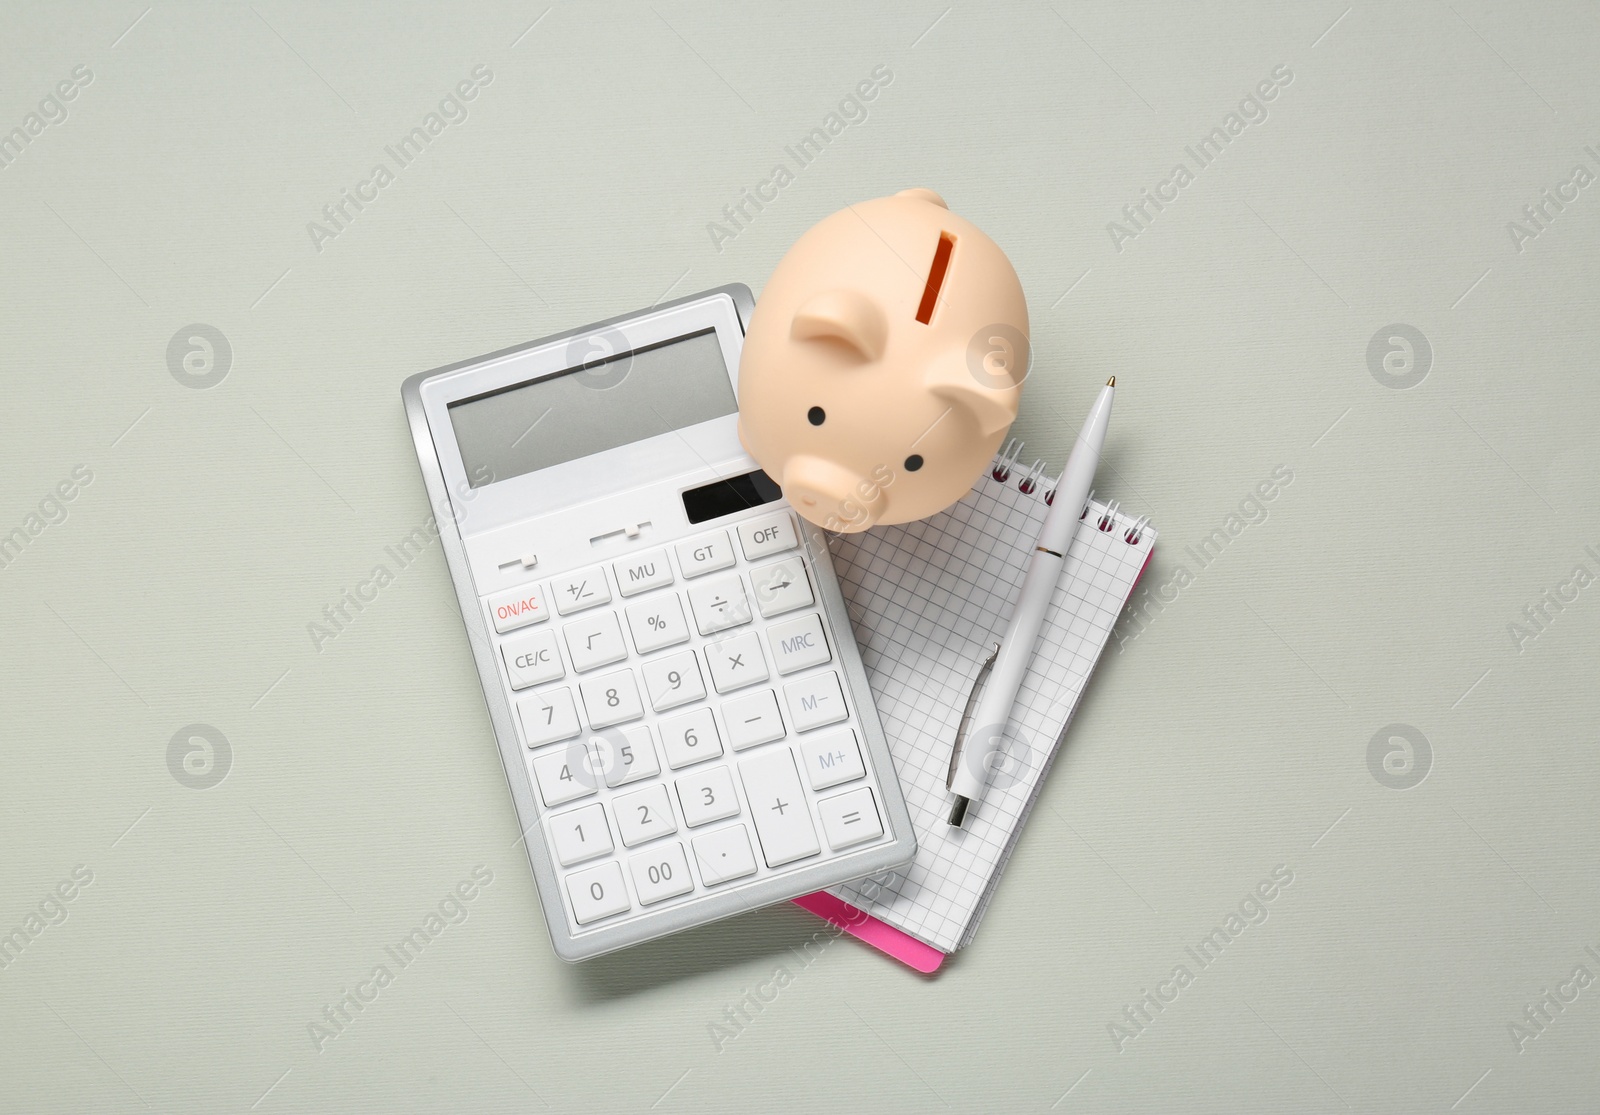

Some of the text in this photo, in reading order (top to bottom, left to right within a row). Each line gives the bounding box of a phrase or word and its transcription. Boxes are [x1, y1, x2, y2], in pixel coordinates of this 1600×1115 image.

[497, 596, 539, 620] ON/AC
[628, 562, 656, 582] MU
[693, 545, 714, 562] GT
[753, 526, 780, 544] OFF
[515, 647, 551, 669] CE/C
[647, 614, 667, 632] %
[541, 706, 554, 726] 7
[605, 688, 620, 708] 8
[667, 671, 682, 690] 9
[781, 632, 815, 654] MRC
[559, 764, 574, 783] 4
[620, 746, 634, 765] 5
[684, 728, 698, 748] 6
[574, 825, 585, 842] 1
[637, 805, 653, 825] 2
[700, 786, 715, 806] 3
[818, 751, 846, 770] M+
[590, 882, 605, 901] 0
[647, 862, 673, 885] 00
